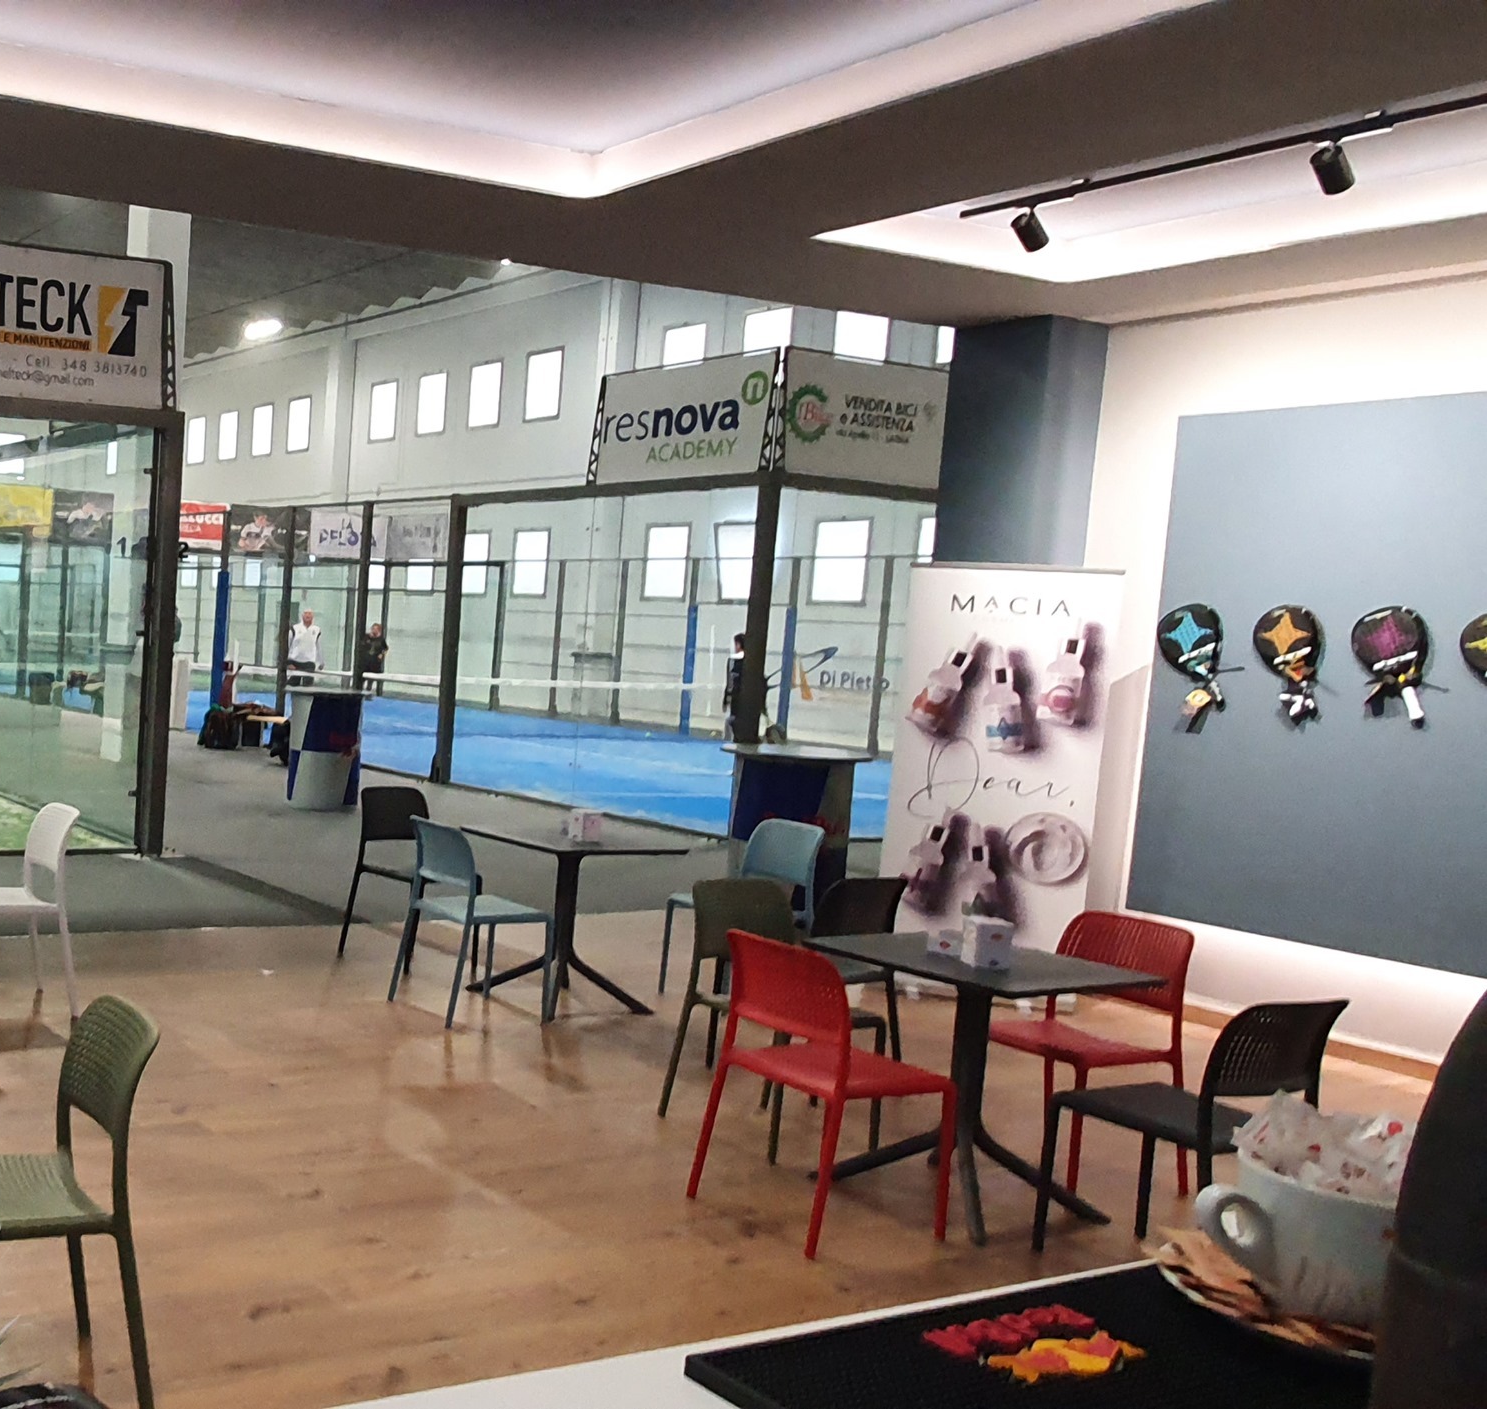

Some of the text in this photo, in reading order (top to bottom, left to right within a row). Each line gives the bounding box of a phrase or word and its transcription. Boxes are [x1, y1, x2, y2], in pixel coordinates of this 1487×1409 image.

[13, 331, 91, 351] MANUTENZIONI
[61, 358, 87, 372] 348
[845, 393, 893, 415] VENDITA
[603, 398, 740, 445] resnova
[850, 412, 915, 433] ASSISTENZA
[646, 437, 738, 464] ACADEMY
[319, 528, 377, 548] PELOA
[950, 593, 1071, 617] MACIA
[840, 670, 891, 692] Pieto
